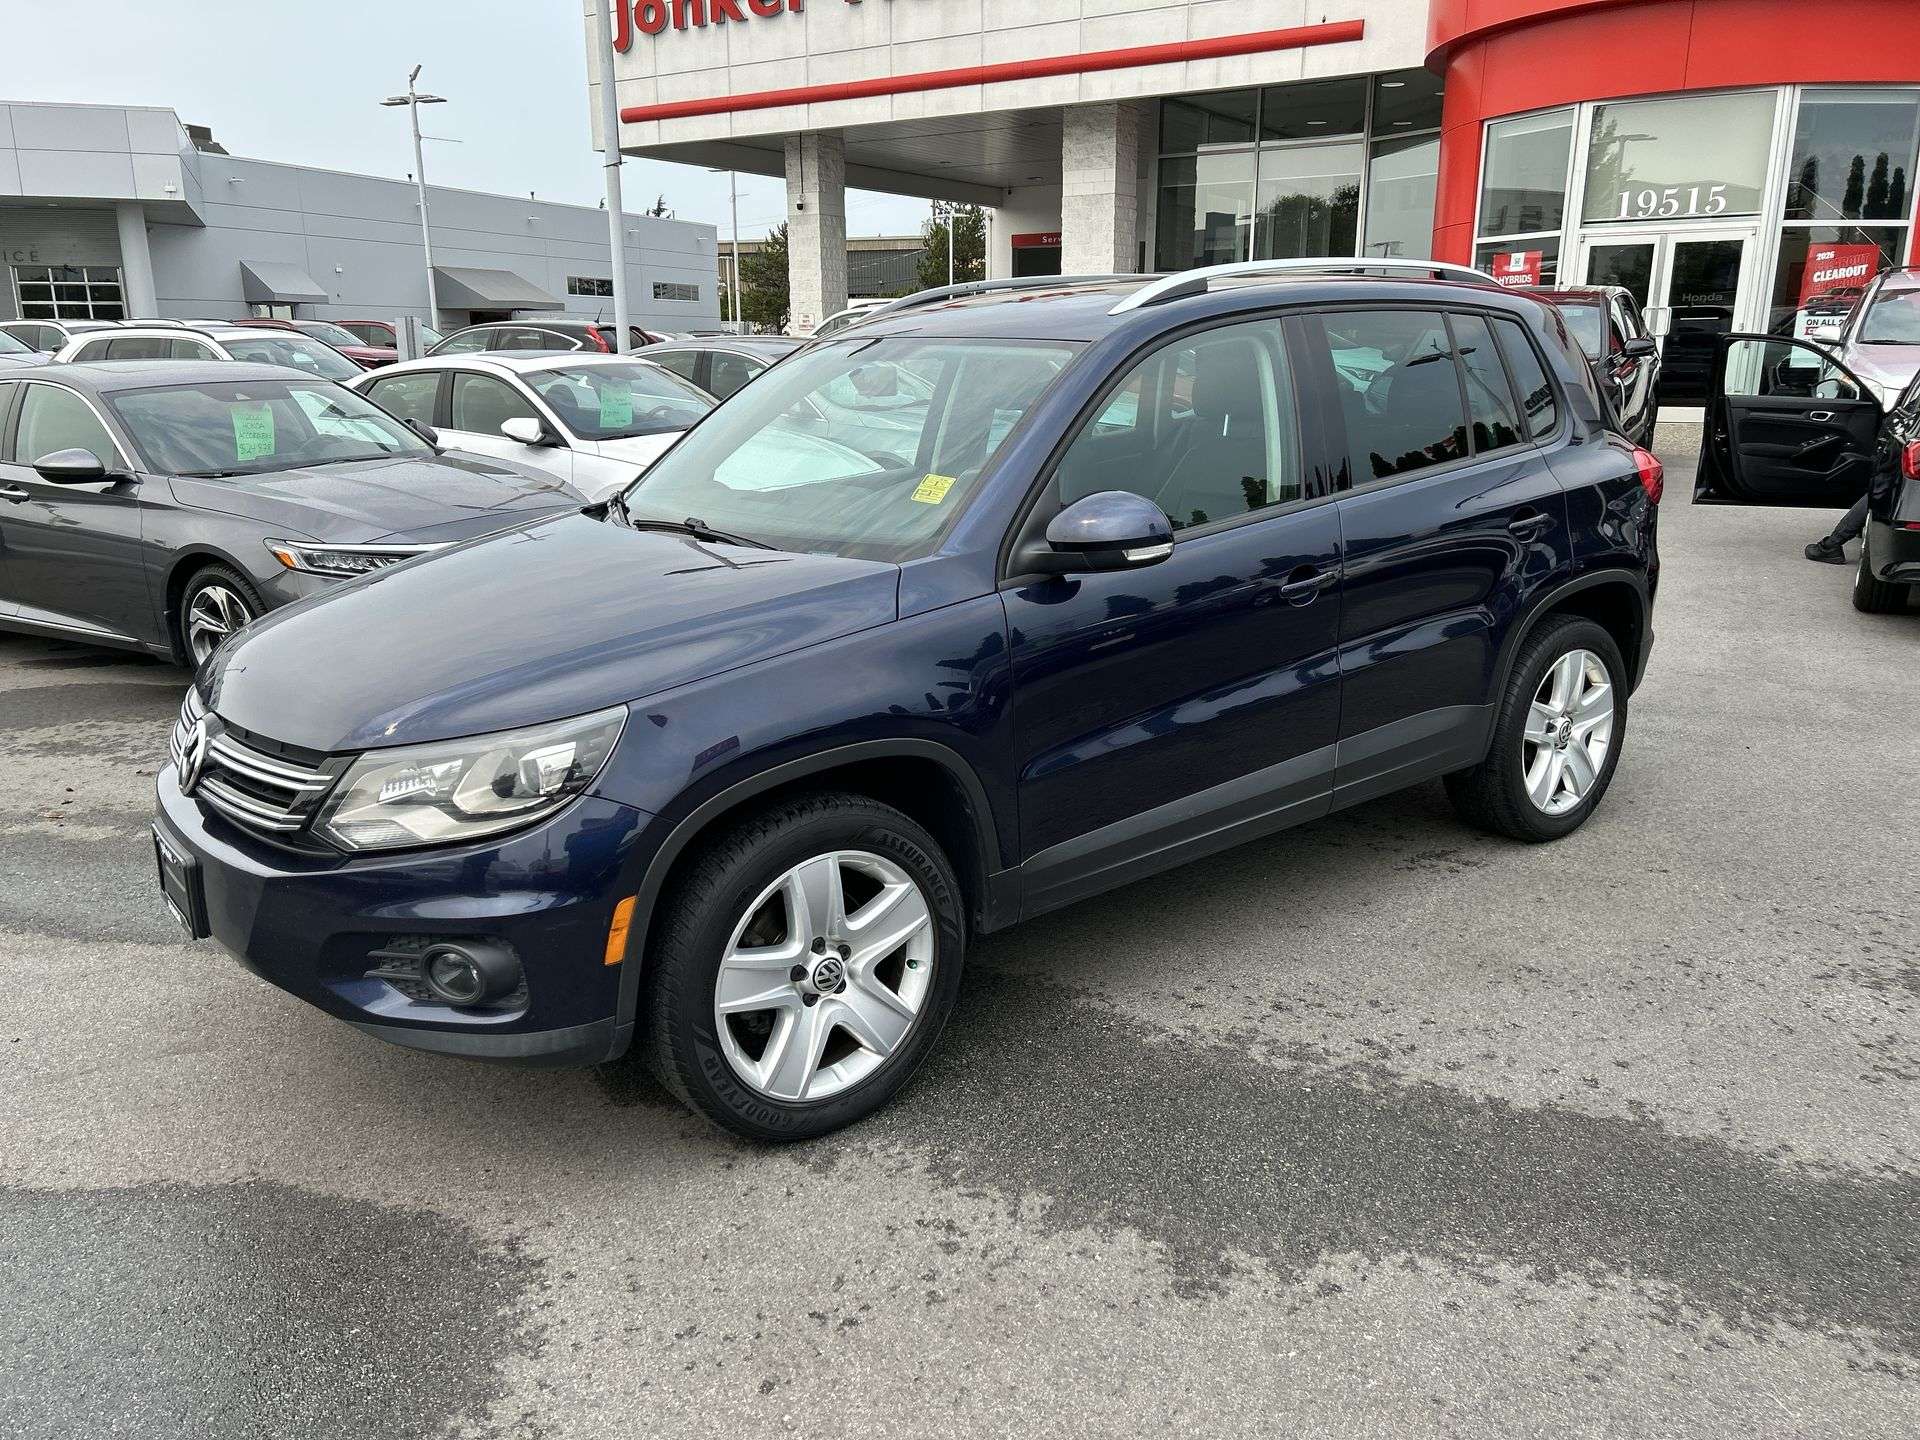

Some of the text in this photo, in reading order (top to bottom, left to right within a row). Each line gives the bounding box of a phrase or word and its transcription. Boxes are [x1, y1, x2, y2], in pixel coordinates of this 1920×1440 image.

[1616, 184, 1727, 219] 19515
[3, 250, 40, 263] ICE
[1813, 264, 1869, 283] CLEAROUT
[1498, 274, 1533, 286] HYBRIDS
[1682, 292, 1723, 302] Honda
[1806, 318, 1819, 326] ON
[1820, 318, 1838, 326] ALL
